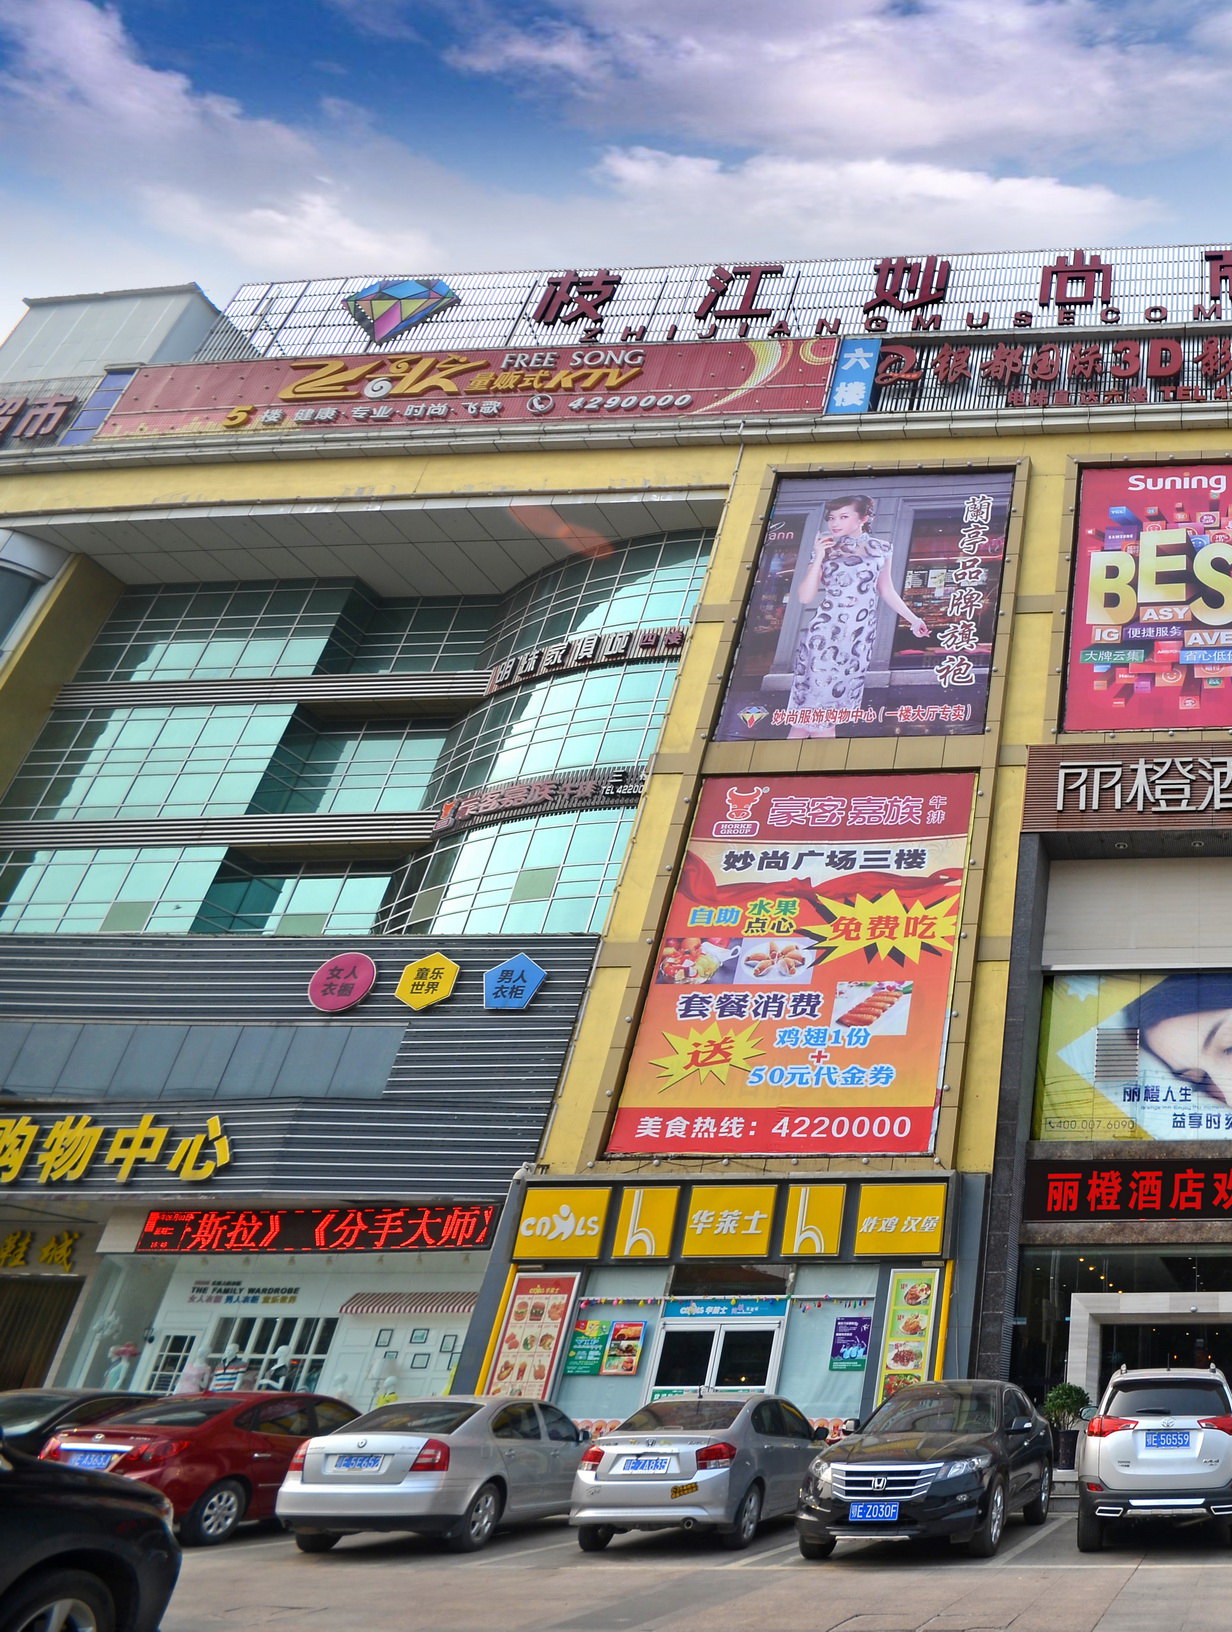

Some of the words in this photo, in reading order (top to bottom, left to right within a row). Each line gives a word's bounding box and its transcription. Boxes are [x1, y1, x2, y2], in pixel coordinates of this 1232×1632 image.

[501, 352, 557, 370] FREE
[569, 349, 645, 368] SONG
[833, 347, 874, 407] 六楼
[567, 393, 693, 412] 4290000
[1159, 384, 1206, 402] TEL
[1127, 472, 1228, 493] Suning
[935, 494, 994, 689] 蘭亭品牌旗袍
[1142, 606, 1190, 622] ASY
[1094, 628, 1120, 642] IG
[1126, 625, 1183, 640] 便捷服务
[1084, 650, 1141, 662] 大牌云集
[767, 795, 924, 827] 豪客嘉族
[926, 796, 948, 825] 牛排
[722, 848, 928, 872] 妙尚广场三楼
[688, 907, 741, 927] 自助
[747, 898, 800, 917] 水果
[743, 916, 797, 936] 点心
[829, 914, 938, 942] 免费吃
[326, 965, 359, 981] 女人
[414, 967, 445, 981] 童乐
[498, 969, 528, 984] 男人
[410, 980, 440, 995] 世界
[492, 983, 525, 1001] 衣柜
[675, 991, 823, 1021] 套餐消费
[776, 1026, 872, 1048] 鸡翅1份
[682, 1035, 735, 1069] 送
[746, 1065, 896, 1087] 50元代金券
[1122, 1085, 1193, 1103] 丽橙人生
[688, 1209, 769, 1236] 华莱士
[247, 1287, 300, 1295] WARDROBE
